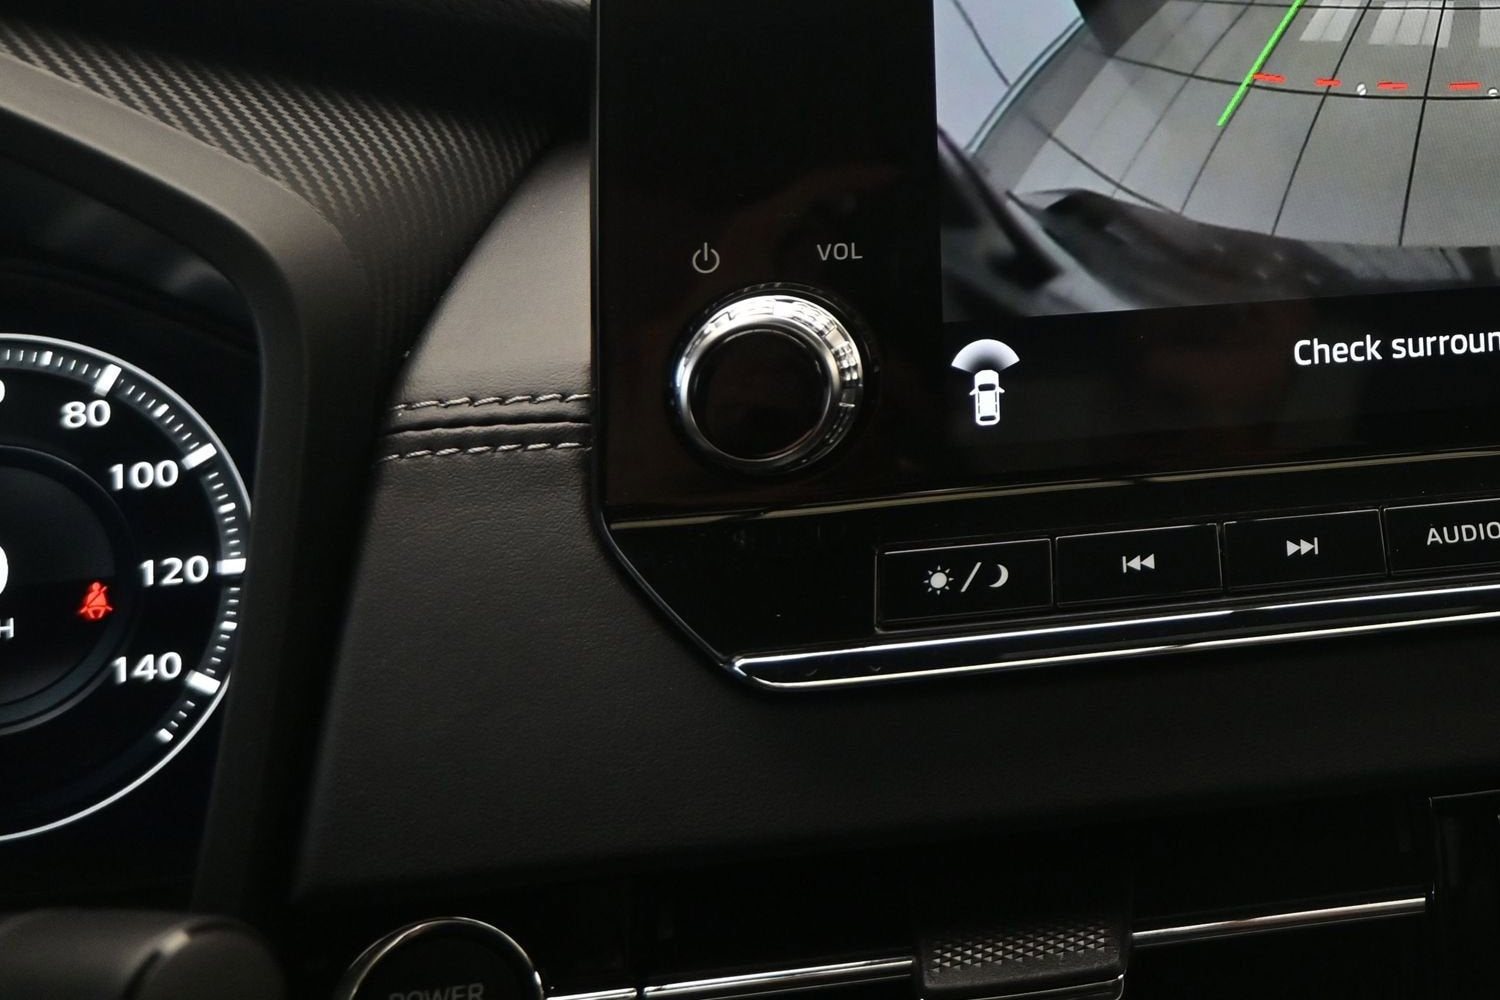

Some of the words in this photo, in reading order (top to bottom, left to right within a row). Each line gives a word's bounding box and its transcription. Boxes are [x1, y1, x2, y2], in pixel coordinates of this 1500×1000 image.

[817, 243, 862, 260] VOL
[1294, 335, 1382, 365] Check
[64, 400, 110, 427] 80
[111, 460, 178, 489] 100
[142, 556, 209, 585] 120
[114, 652, 182, 682] 140
